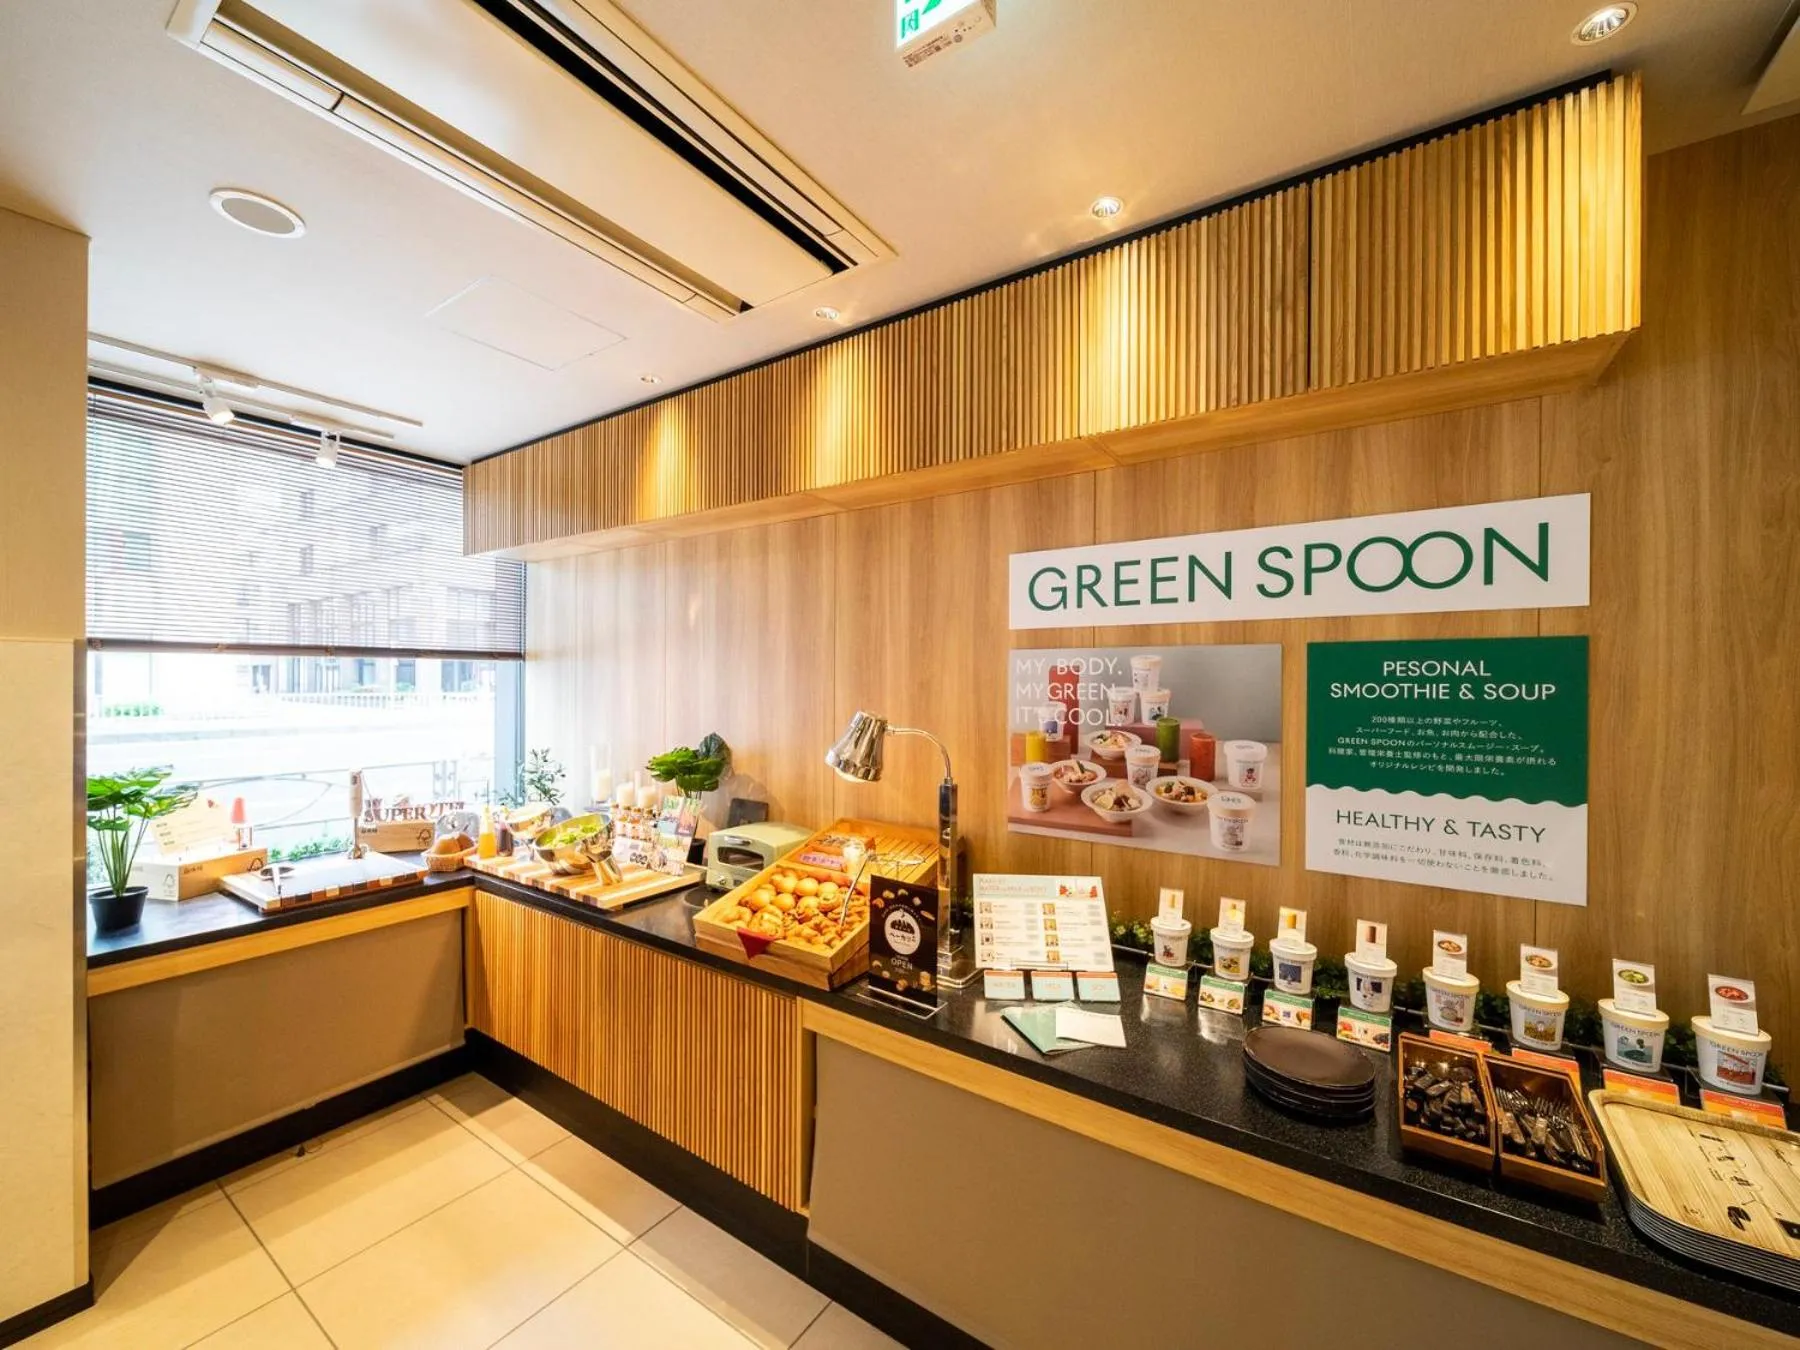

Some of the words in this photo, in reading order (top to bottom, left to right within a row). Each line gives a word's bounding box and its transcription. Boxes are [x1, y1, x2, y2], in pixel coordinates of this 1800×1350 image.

[1028, 551, 1232, 612] GREEN
[1256, 522, 1550, 599] SPOON
[1016, 658, 1046, 674] MY
[1056, 657, 1123, 675] BODY.
[1383, 660, 1492, 677] PESONAL
[1016, 682, 1044, 699] MY
[1330, 683, 1450, 699] SMOOTHIE
[1459, 683, 1475, 700] &
[1483, 683, 1556, 700] SOUP
[1016, 706, 1053, 724] IT'
[1054, 707, 1122, 727] COOL.
[1337, 737, 1368, 745] GREEN
[1336, 809, 1436, 832] HEALTHY
[1443, 819, 1459, 836] &
[1466, 821, 1546, 843] TASTY
[890, 958, 914, 971] OPEN
